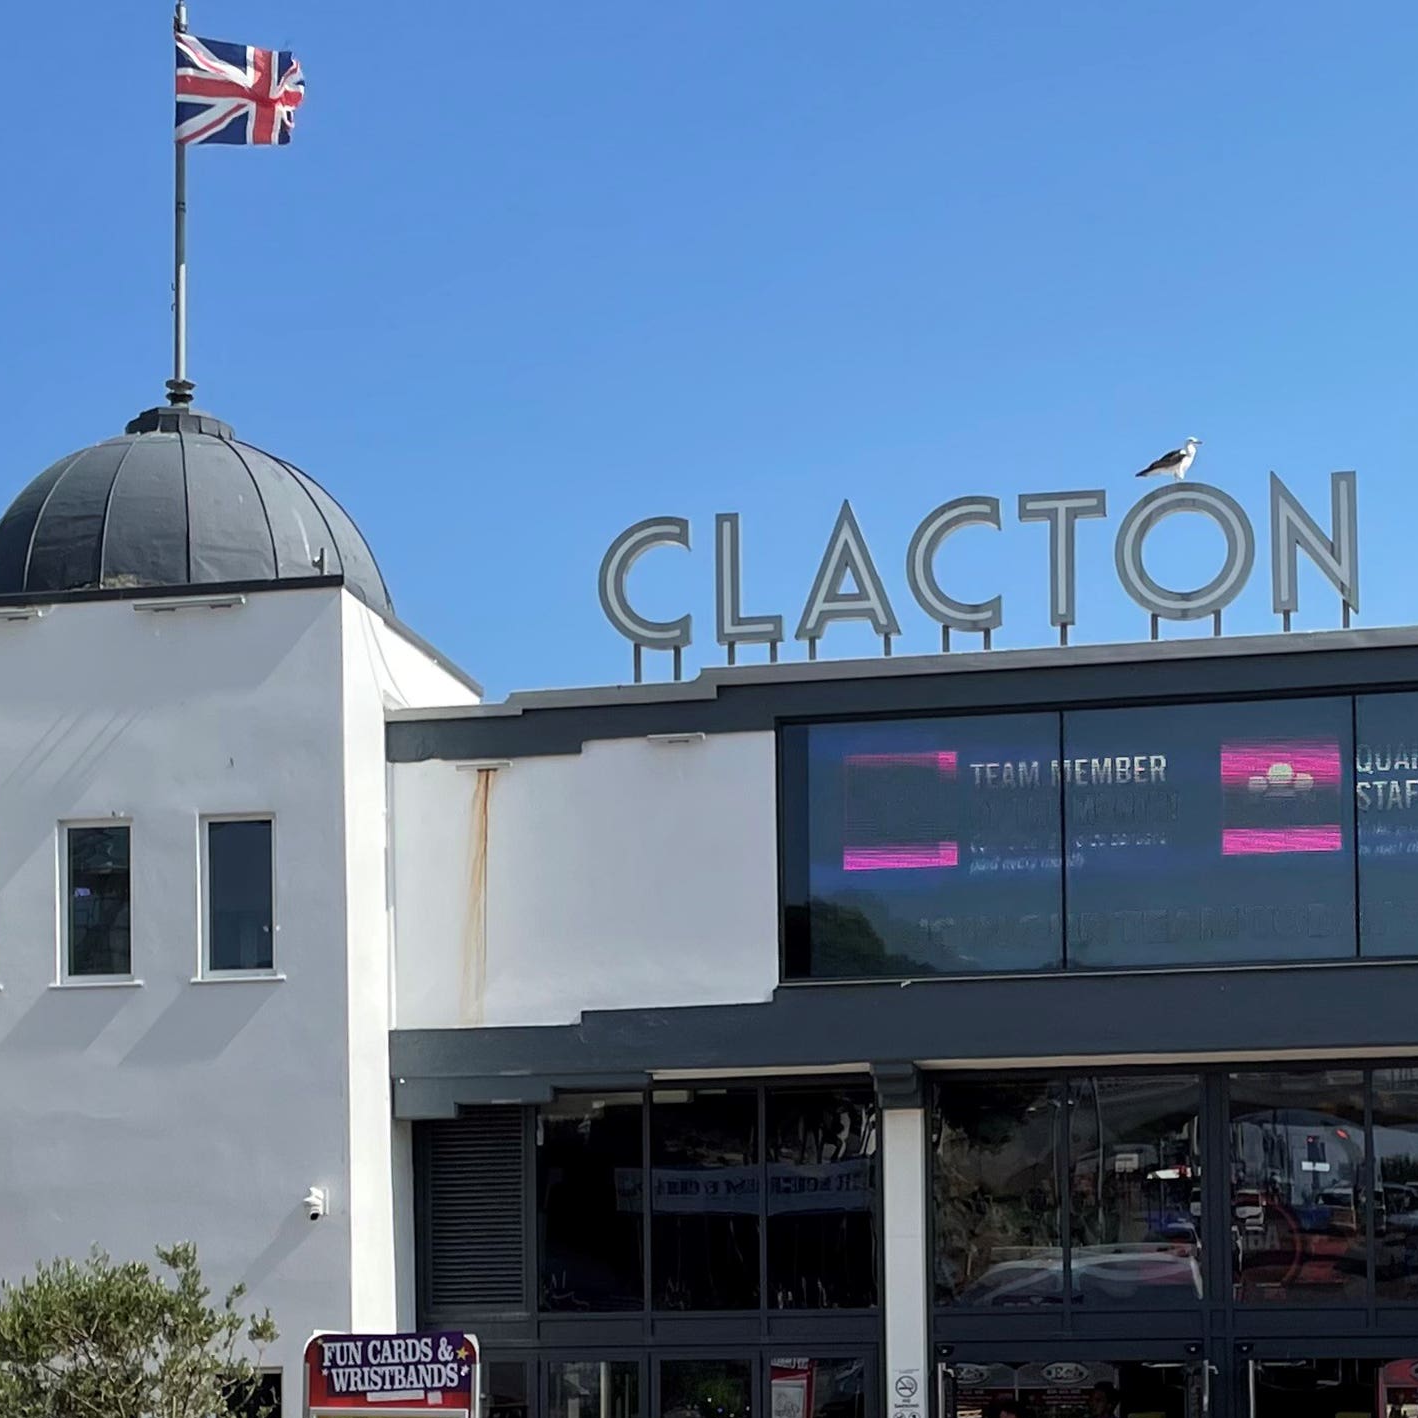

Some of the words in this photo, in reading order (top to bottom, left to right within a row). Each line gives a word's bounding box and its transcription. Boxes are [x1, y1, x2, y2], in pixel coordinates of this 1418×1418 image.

[598, 470, 1359, 650] CLACTON
[970, 761, 1040, 787] TEAM
[1051, 755, 1167, 786] MEMBER
[322, 1341, 363, 1367] FUN
[367, 1338, 433, 1365] CARDS
[437, 1336, 455, 1362] &
[331, 1362, 459, 1392] WRISTBANDS
